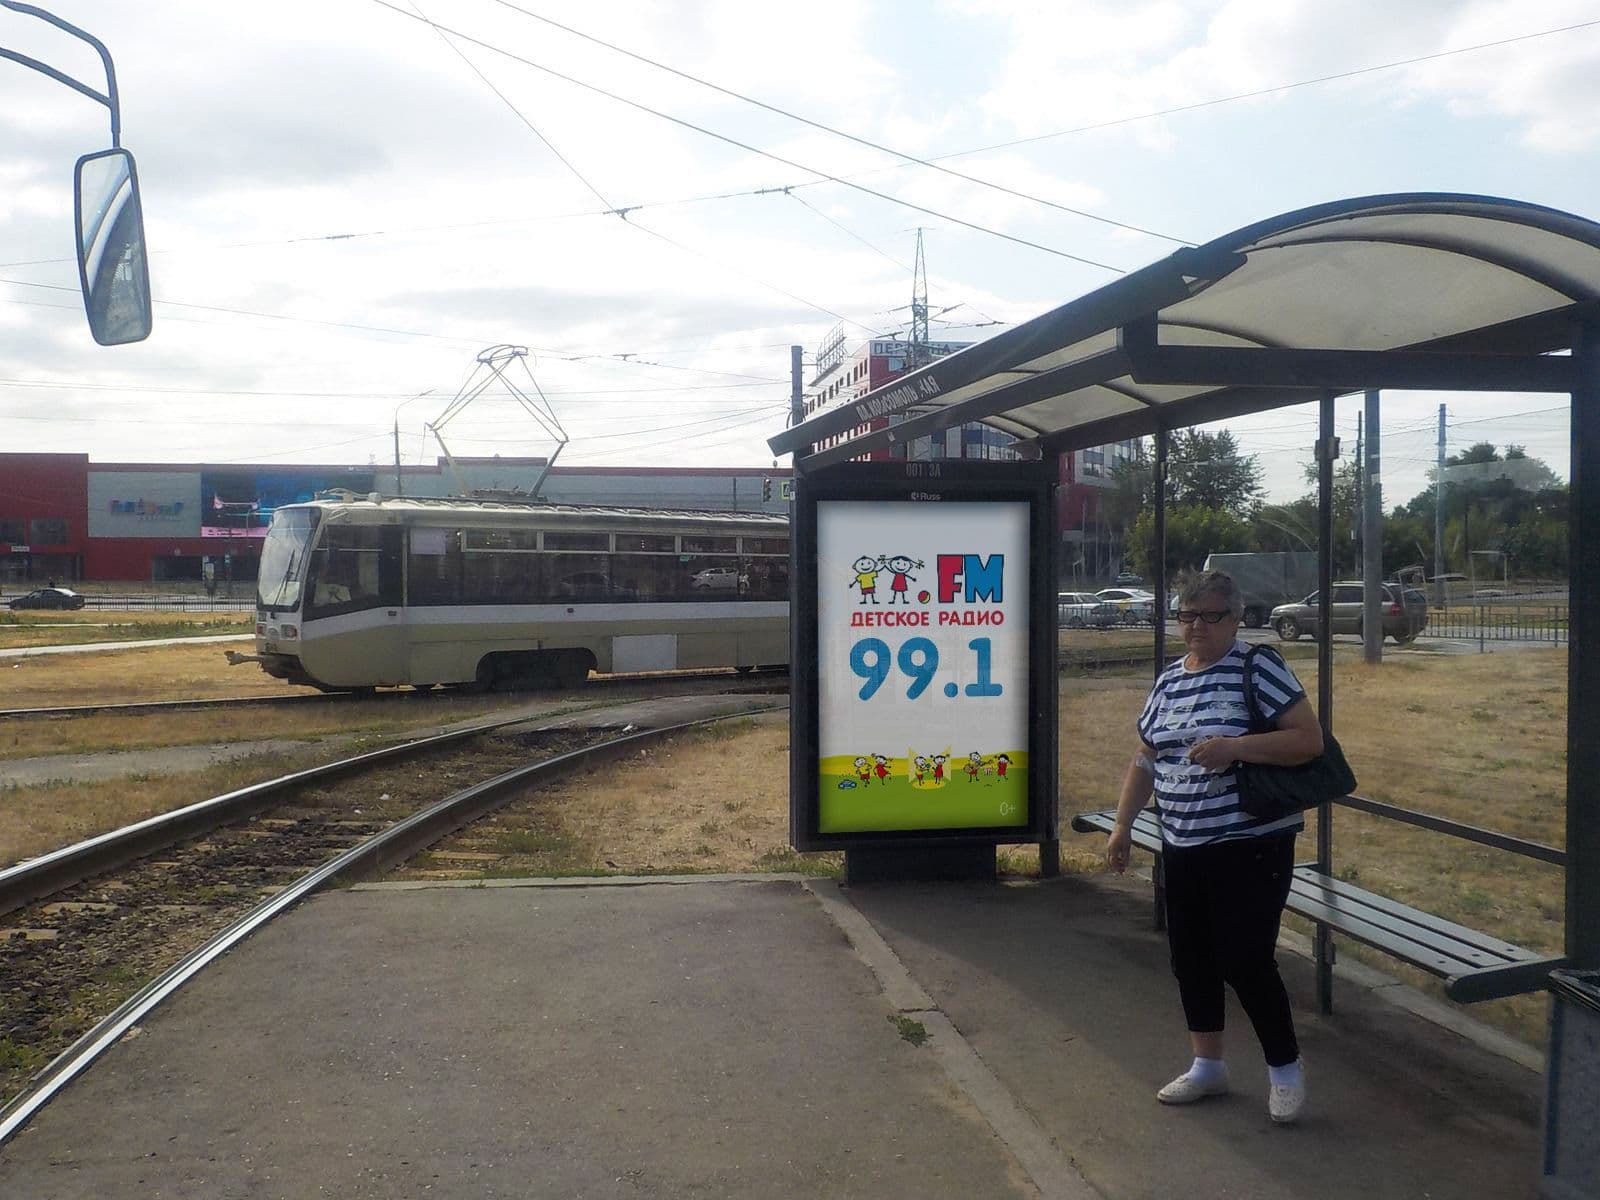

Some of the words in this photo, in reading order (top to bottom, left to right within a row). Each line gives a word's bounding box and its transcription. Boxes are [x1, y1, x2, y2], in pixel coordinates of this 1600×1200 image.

[920, 492, 943, 501] Russ
[850, 611, 930, 627] ДЕТСКОЕ
[938, 610, 1005, 626] РАДИО
[849, 637, 1003, 700] 99.1
[999, 801, 1016, 816] 0+
